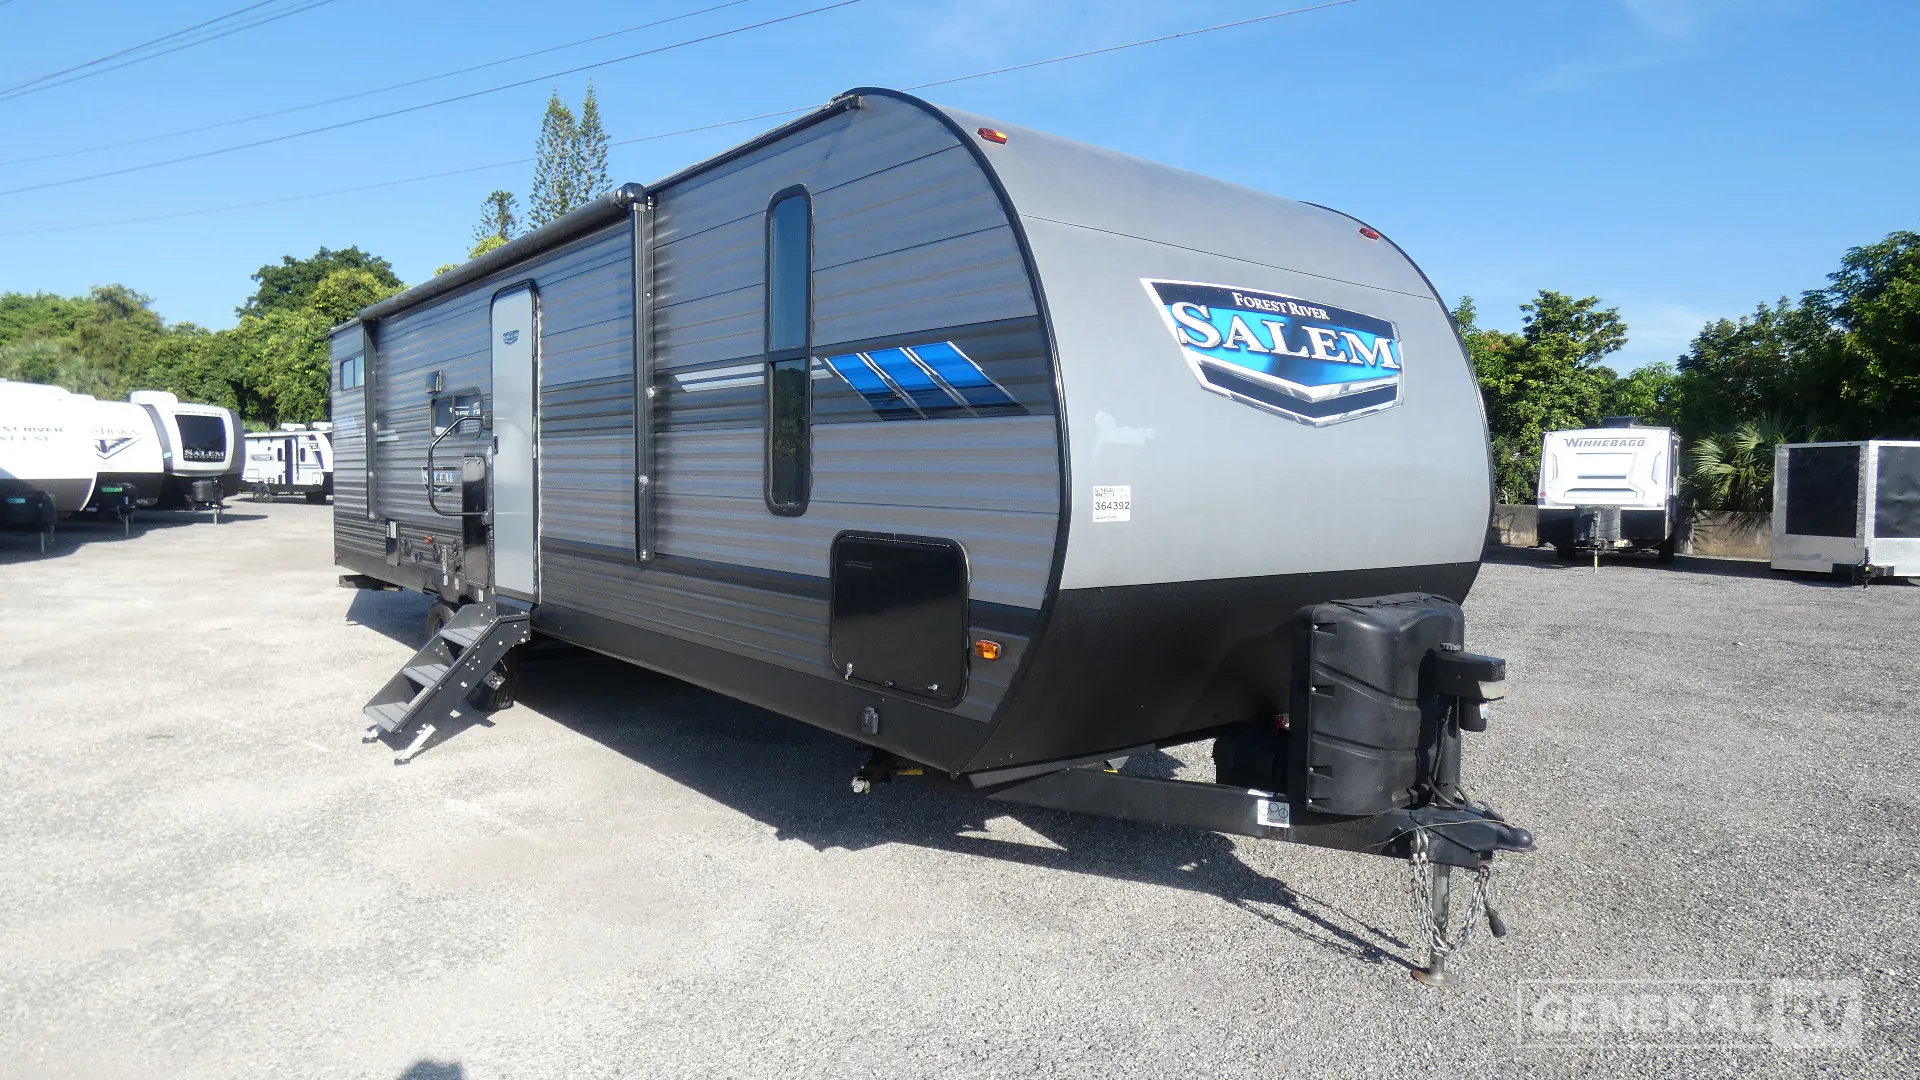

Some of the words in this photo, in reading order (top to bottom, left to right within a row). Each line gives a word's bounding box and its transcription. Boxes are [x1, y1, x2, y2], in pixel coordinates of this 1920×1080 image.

[1232, 292, 1287, 313] FOREST
[1290, 302, 1330, 320] RIVER
[1171, 301, 1400, 369] SALEM
[1094, 501, 1130, 511] 364392
